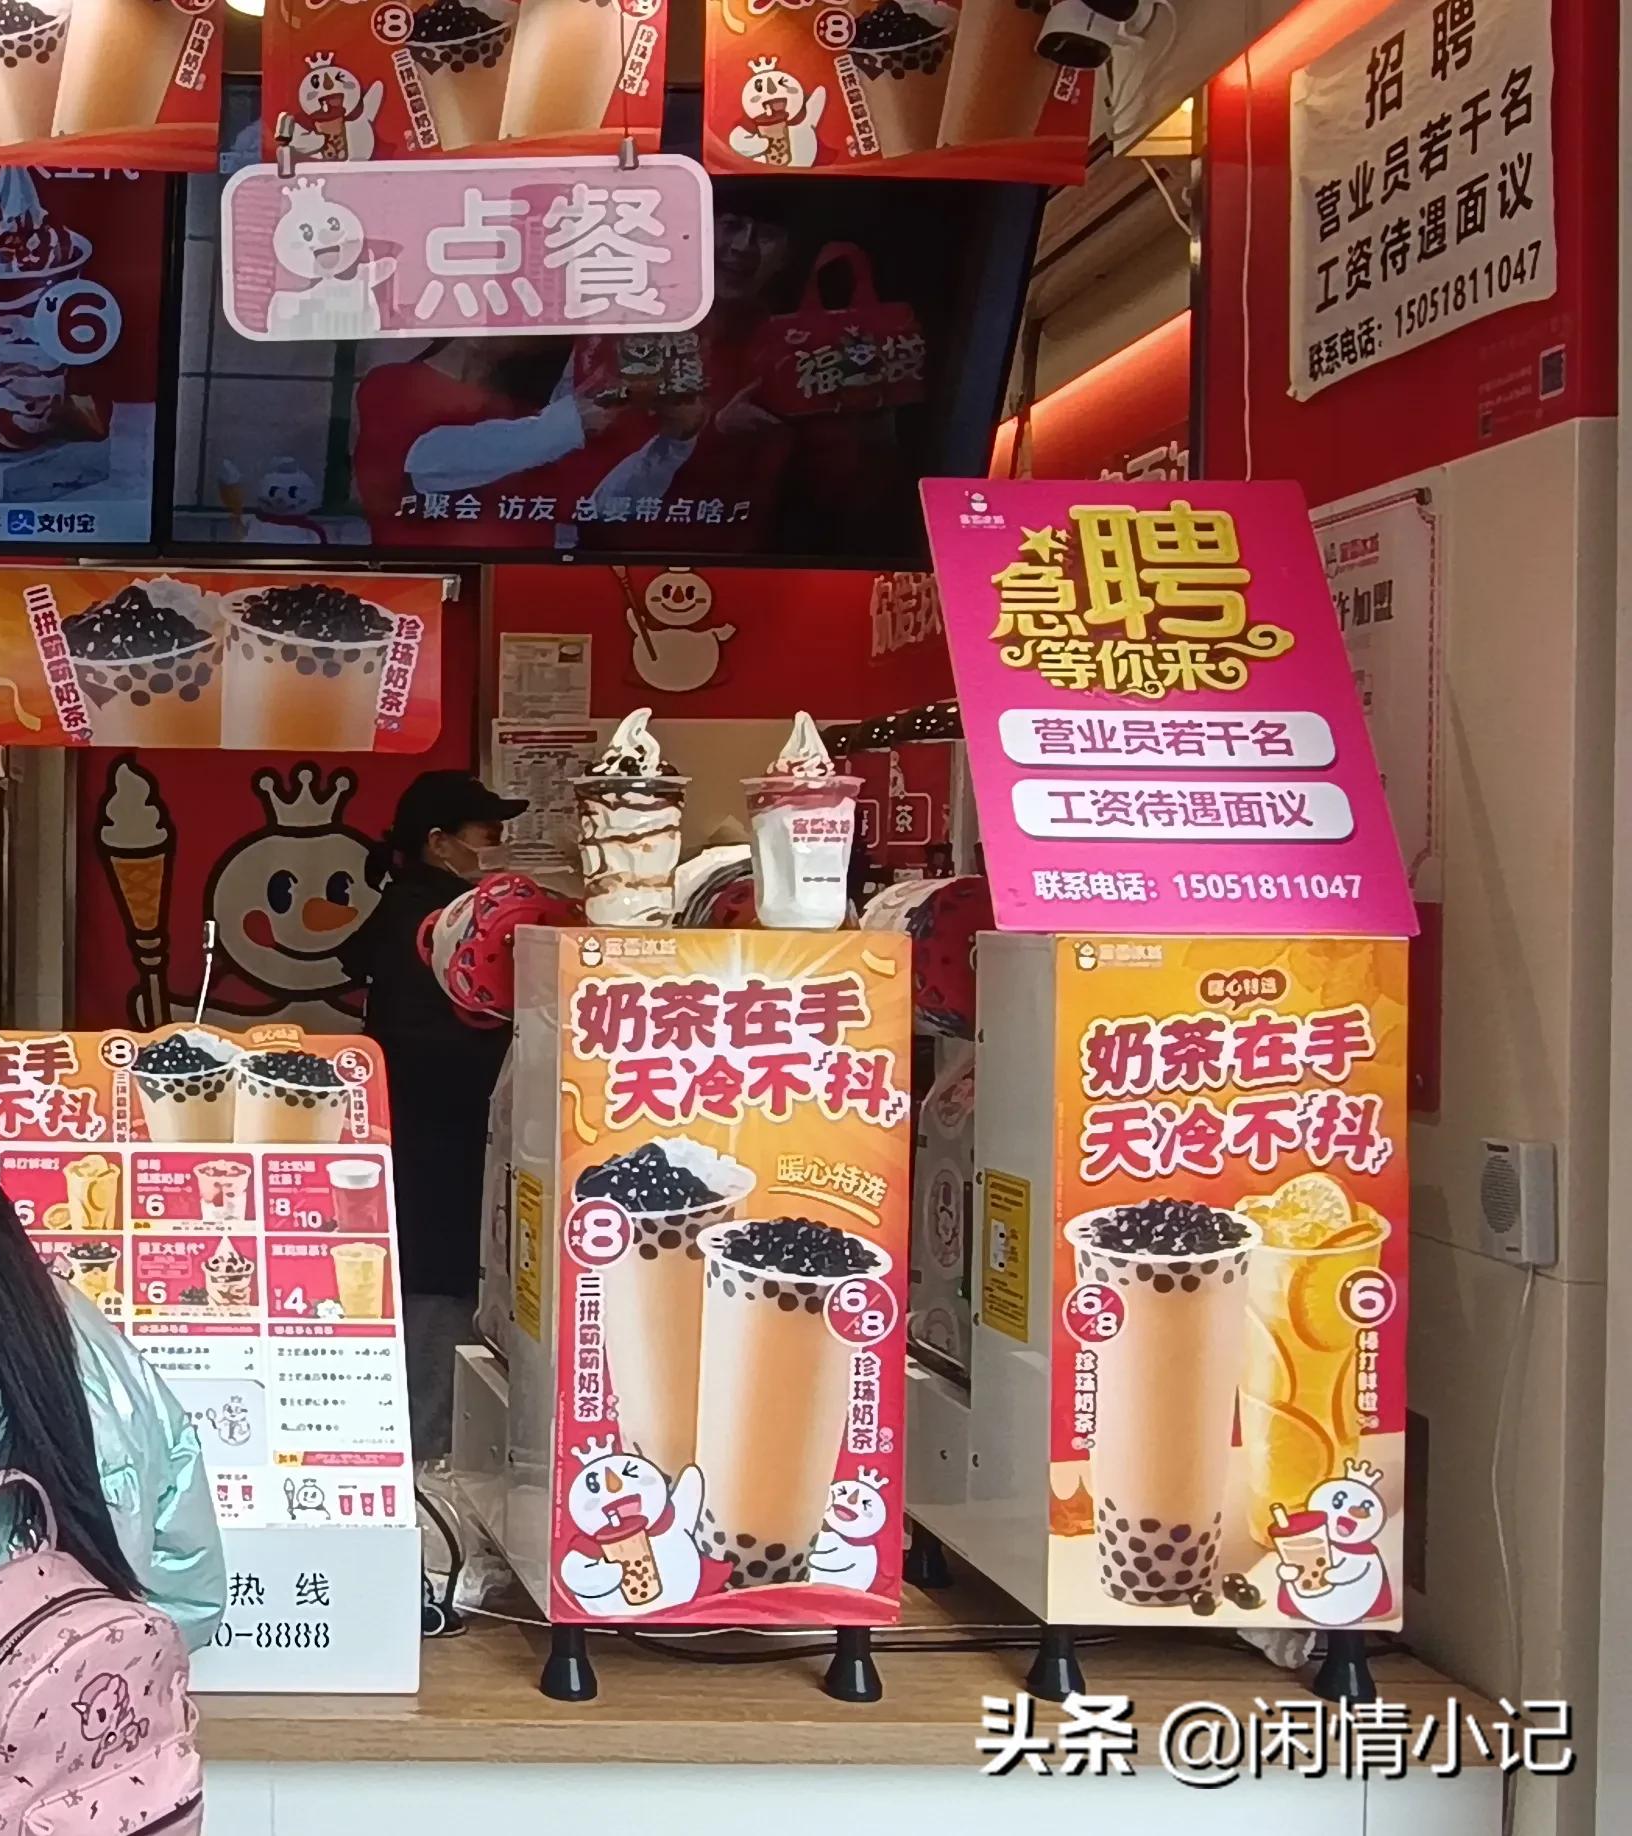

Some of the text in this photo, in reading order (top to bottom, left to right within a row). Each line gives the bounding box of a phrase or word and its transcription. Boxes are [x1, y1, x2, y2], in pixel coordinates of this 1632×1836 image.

[1365, 0, 1477, 129] 招聘
[1315, 64, 1534, 244] 营业员若干名
[414, 184, 672, 320] 点餐
[1315, 151, 1534, 314] 工资待遇面议
[1394, 240, 1543, 340] 15051811047
[36, 512, 96, 534] 支付宝
[423, 493, 725, 525] 聚会 访友 总要带点啥
[1036, 638, 1220, 698] 等你来
[1031, 717, 1295, 759] 营业员若干名
[1047, 787, 1314, 829] 工资待遇面议
[1173, 872, 1363, 901] 15051811047
[575, 976, 866, 1054] 奶茶在手
[1086, 1011, 1372, 1092] 奶茶在手
[610, 1052, 892, 1123] 天冷不抖
[1086, 1094, 1383, 1176] 天冷不抖
[775, 1153, 889, 1207] 暖心特选
[849, 1351, 881, 1452] 珍珠奶茶
[228, 1571, 331, 1607] 热线
[206, 1621, 332, 1650] 0-8888
